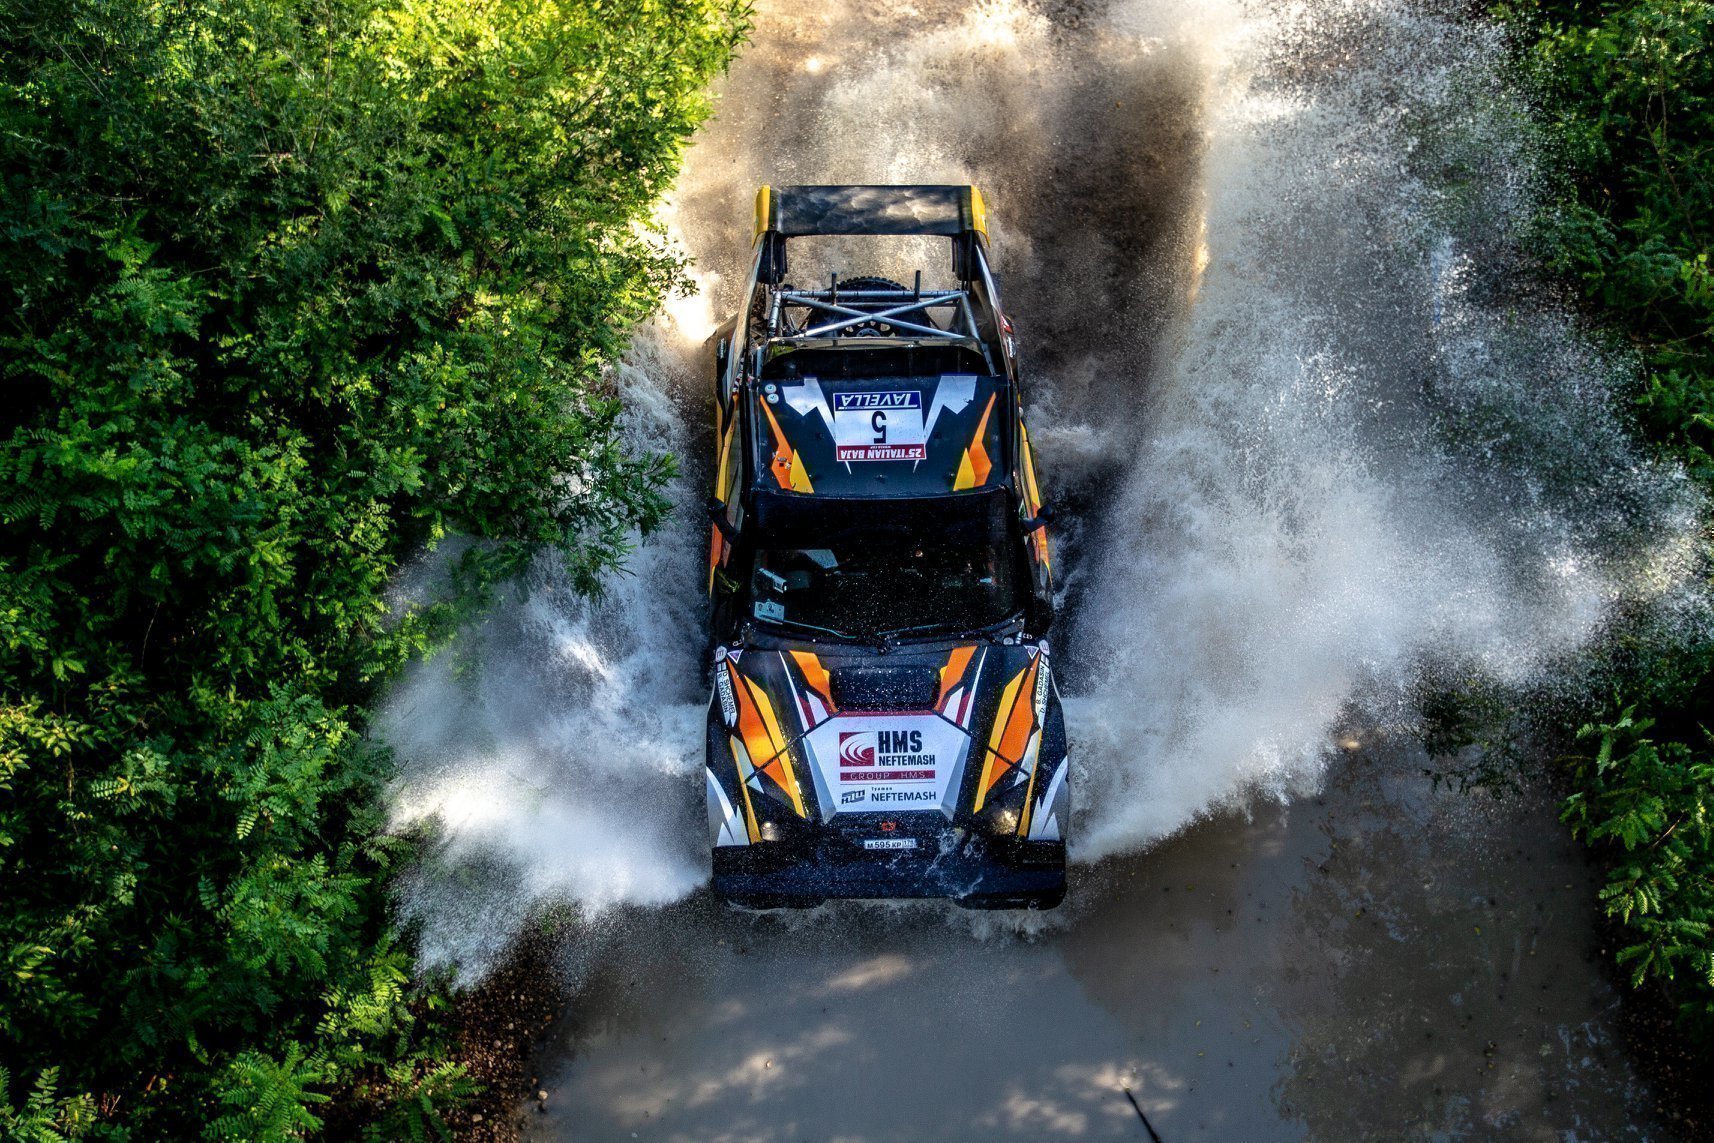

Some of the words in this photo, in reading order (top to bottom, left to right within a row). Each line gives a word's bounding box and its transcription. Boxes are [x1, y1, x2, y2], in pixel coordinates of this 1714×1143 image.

[841, 393, 912, 407] TAVELLA
[871, 410, 887, 444] 5
[840, 449, 865, 459] BAJA
[867, 448, 905, 459] ITALIAN
[1037, 666, 1045, 696] GADASIN
[719, 681, 729, 713] GADASIN
[878, 730, 923, 753] HMS
[878, 754, 936, 767] NEFTEMASH
[850, 772, 890, 780] GROUP
[900, 771, 925, 779] HMS
[871, 791, 937, 802] NEFTEMASH
